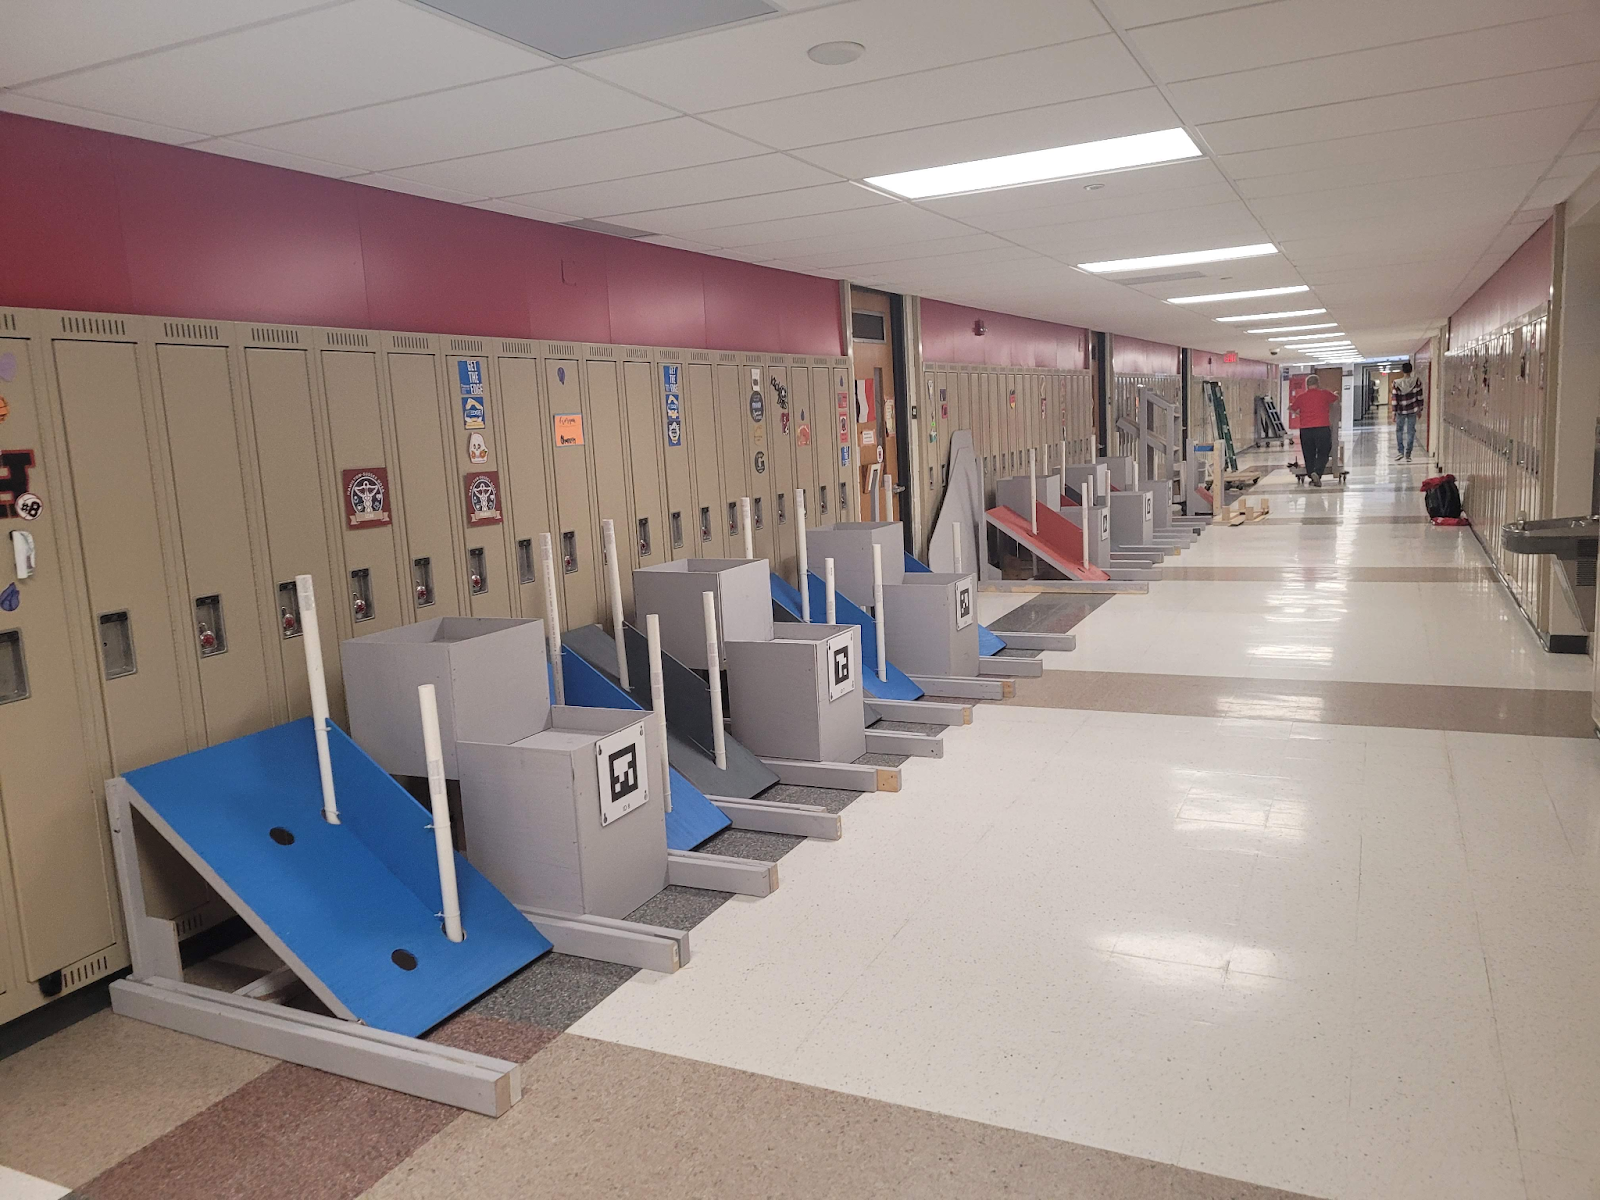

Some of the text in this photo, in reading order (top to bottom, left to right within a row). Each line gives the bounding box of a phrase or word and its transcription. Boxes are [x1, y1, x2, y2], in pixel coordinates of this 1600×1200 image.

[467, 361, 477, 372] GET
[468, 372, 480, 384] THE
[471, 384, 484, 395] EDGE
